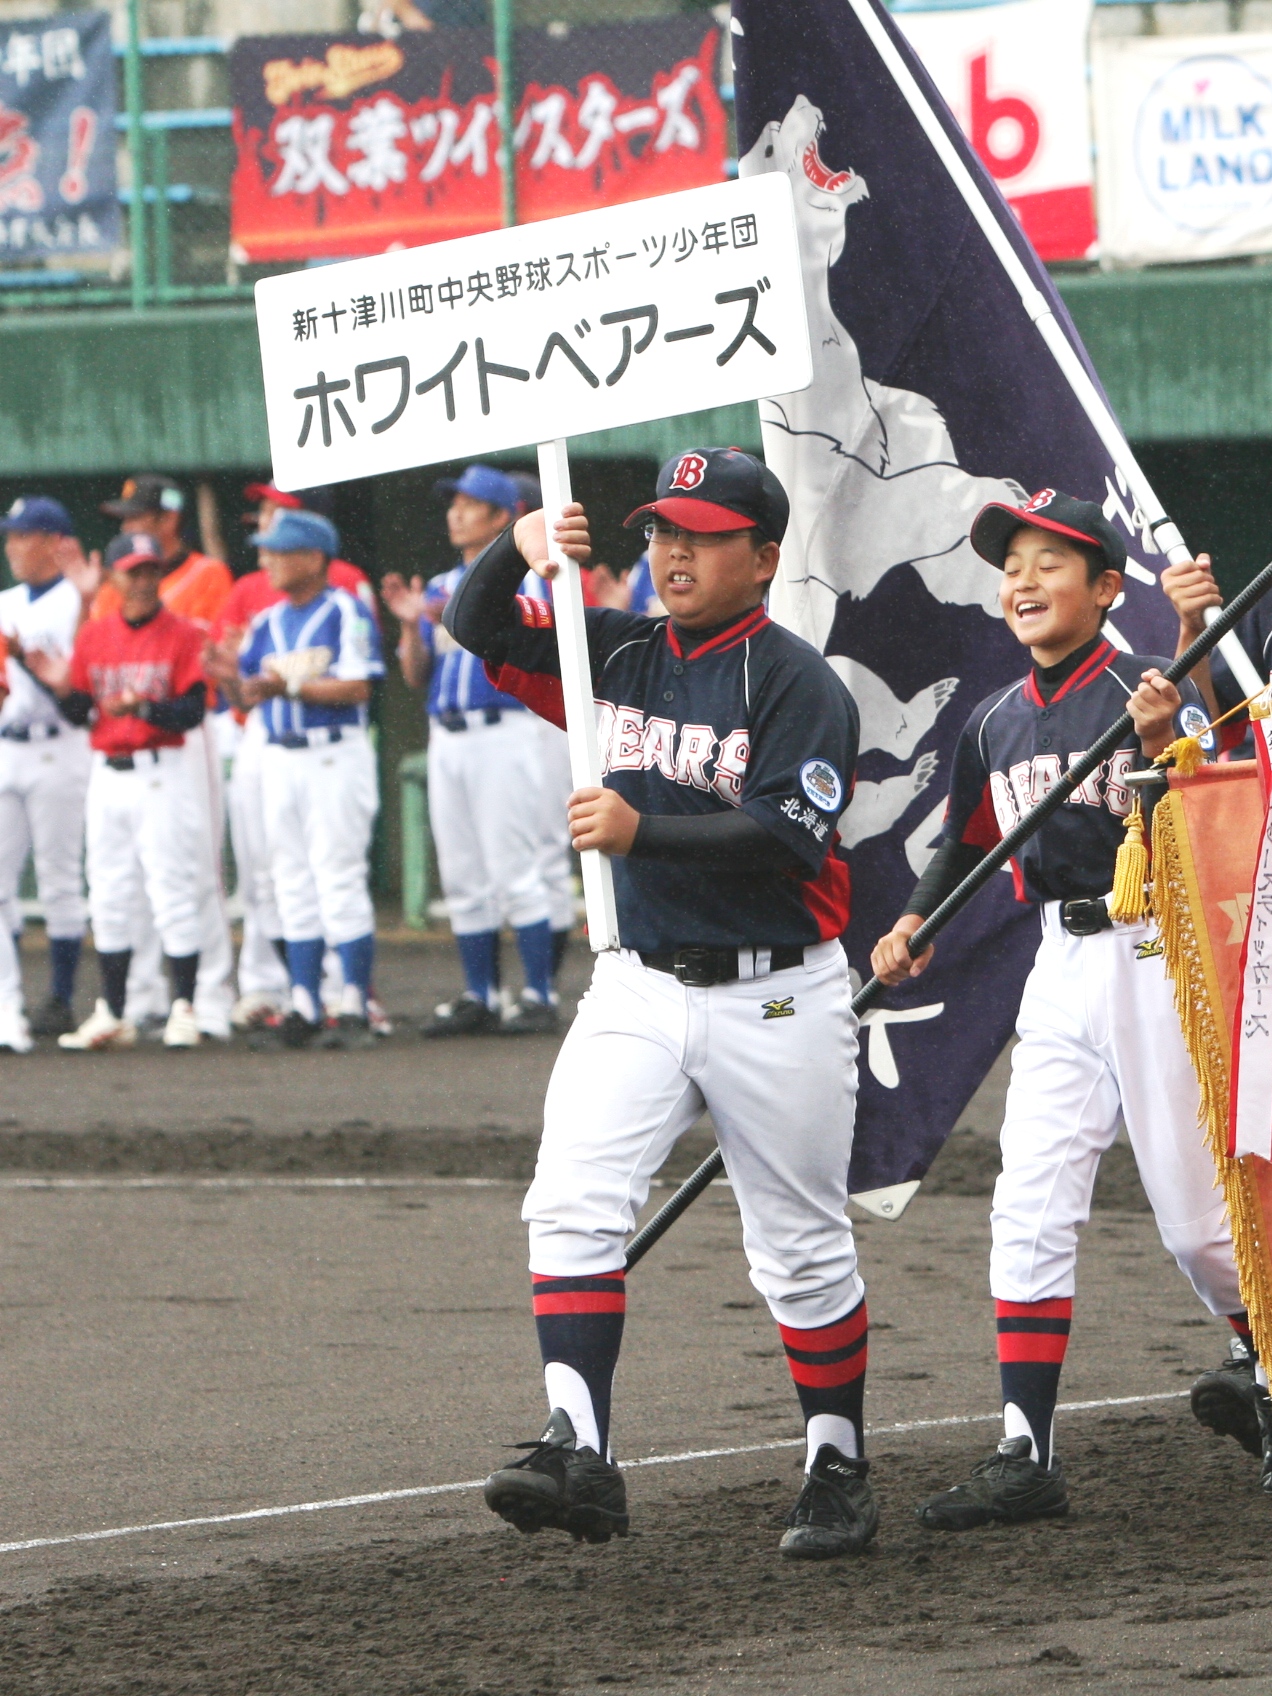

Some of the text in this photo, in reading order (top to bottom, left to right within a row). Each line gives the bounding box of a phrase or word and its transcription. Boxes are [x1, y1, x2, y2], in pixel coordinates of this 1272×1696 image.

[1162, 104, 1266, 143] MILK
[293, 213, 759, 342] 新十津川町中央野球スポーツ少年団
[293, 276, 777, 448] ホワイトベアーズ
[670, 453, 708, 490] B
[1023, 487, 1056, 514] B
[780, 797, 829, 842] 北海道
